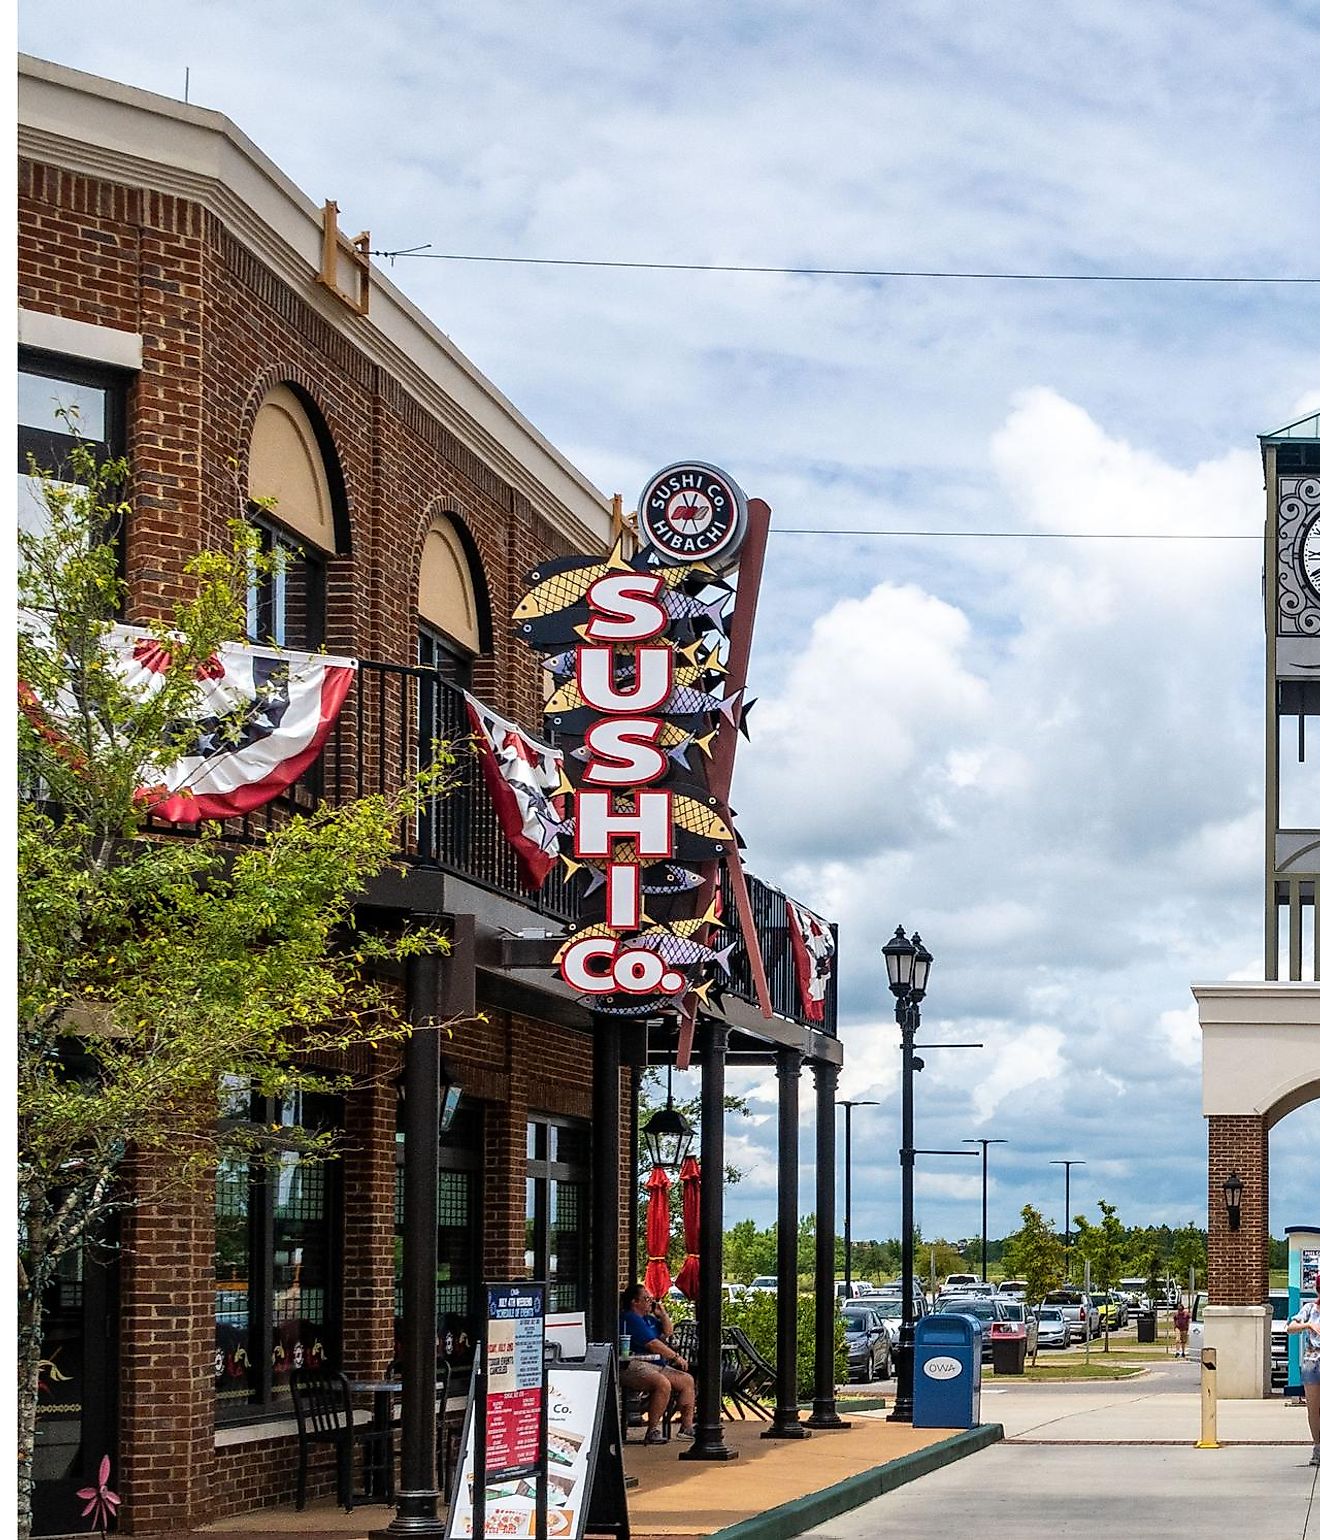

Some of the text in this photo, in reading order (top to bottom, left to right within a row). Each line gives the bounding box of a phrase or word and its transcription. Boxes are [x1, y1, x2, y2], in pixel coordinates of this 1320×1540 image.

[651, 474, 703, 510] SUSHI
[653, 520, 727, 551] HIBACHI
[574, 571, 676, 931] SUSHI
[561, 936, 686, 995] Co.
[929, 1364, 956, 1372] OWA
[553, 1403, 572, 1414] Co.
